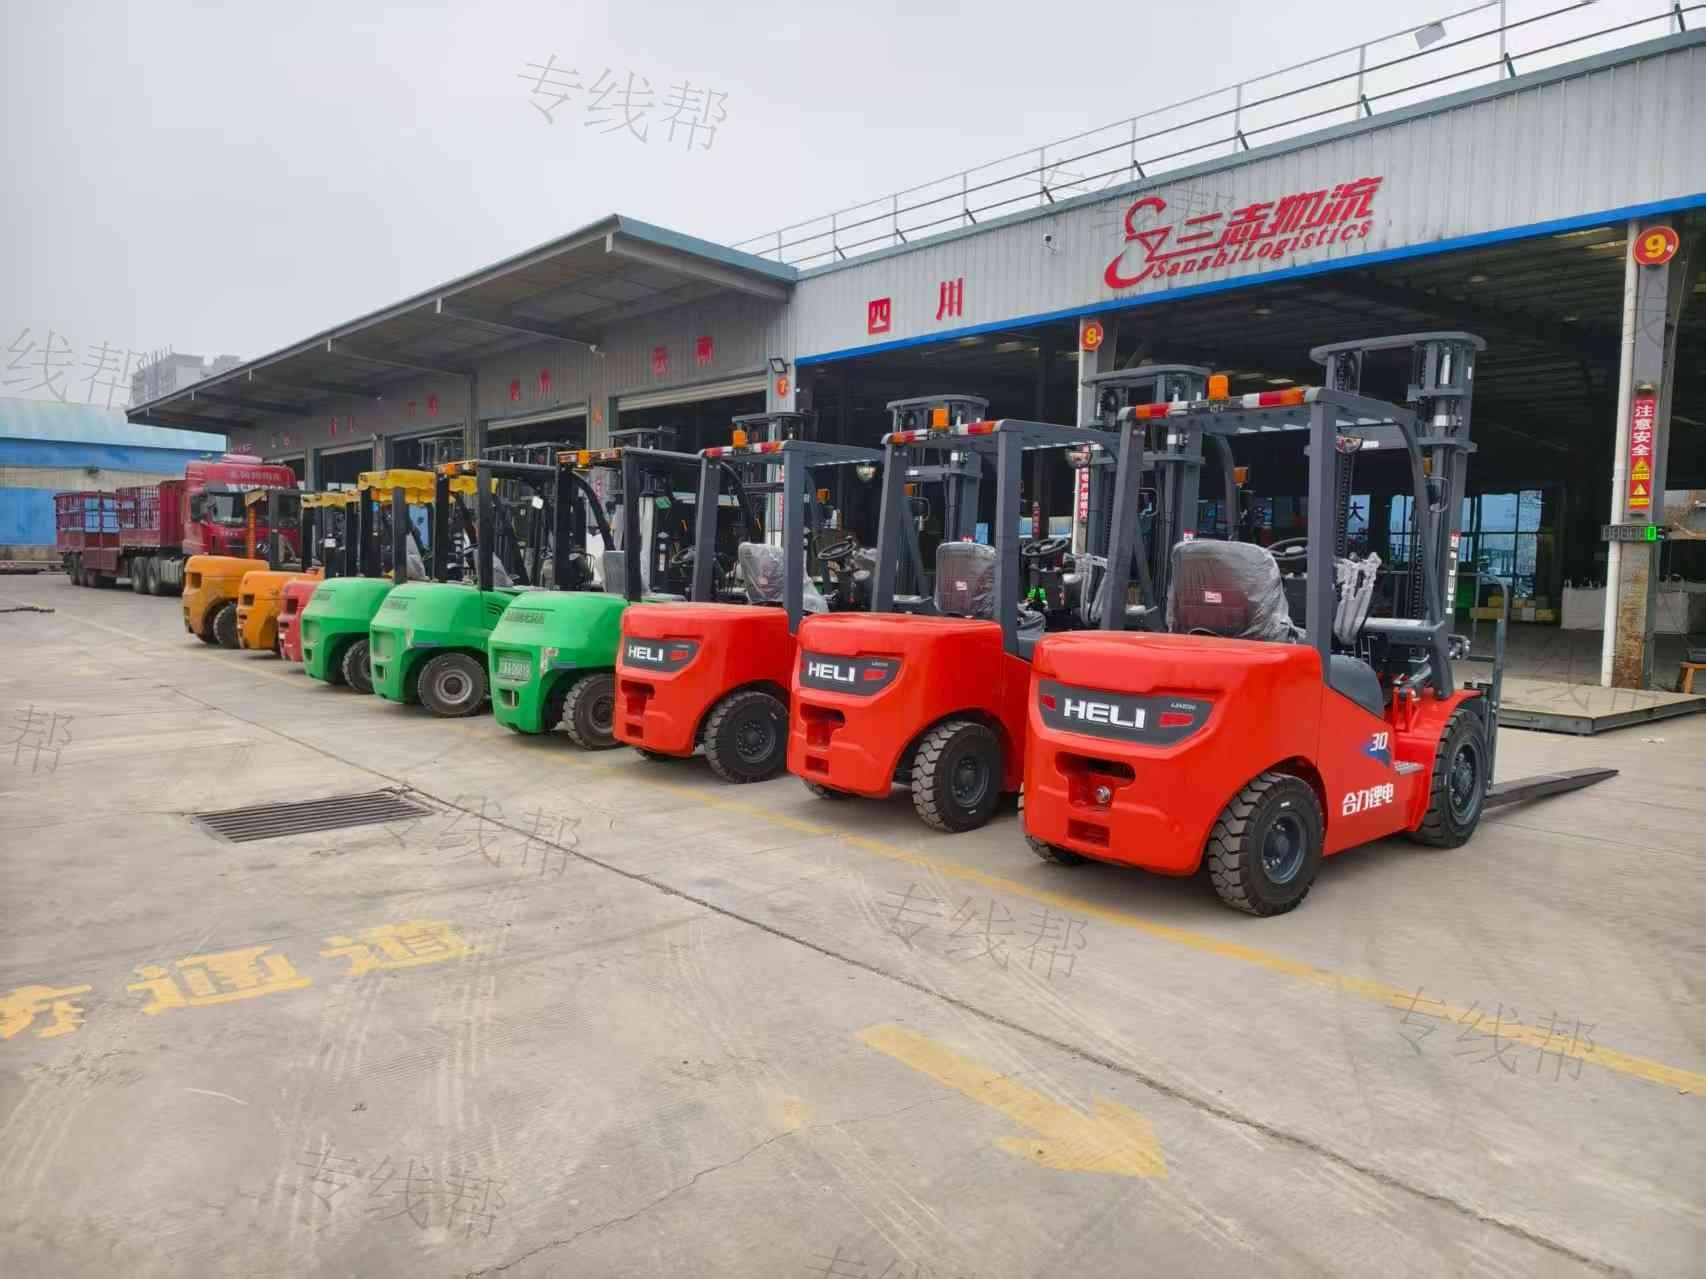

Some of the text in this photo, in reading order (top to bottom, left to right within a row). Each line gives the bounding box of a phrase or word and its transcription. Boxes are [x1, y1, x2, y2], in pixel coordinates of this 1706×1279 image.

[1150, 176, 1384, 262] 三志物流
[1645, 234, 1667, 258] 9
[868, 278, 963, 335] 四川
[1087, 327, 1098, 345] 8
[1632, 405, 1653, 456] 注意安全
[628, 644, 664, 661] HELI
[808, 661, 856, 682] HELI
[1063, 698, 1146, 729] HELI
[1342, 782, 1394, 816] 合力锂电
